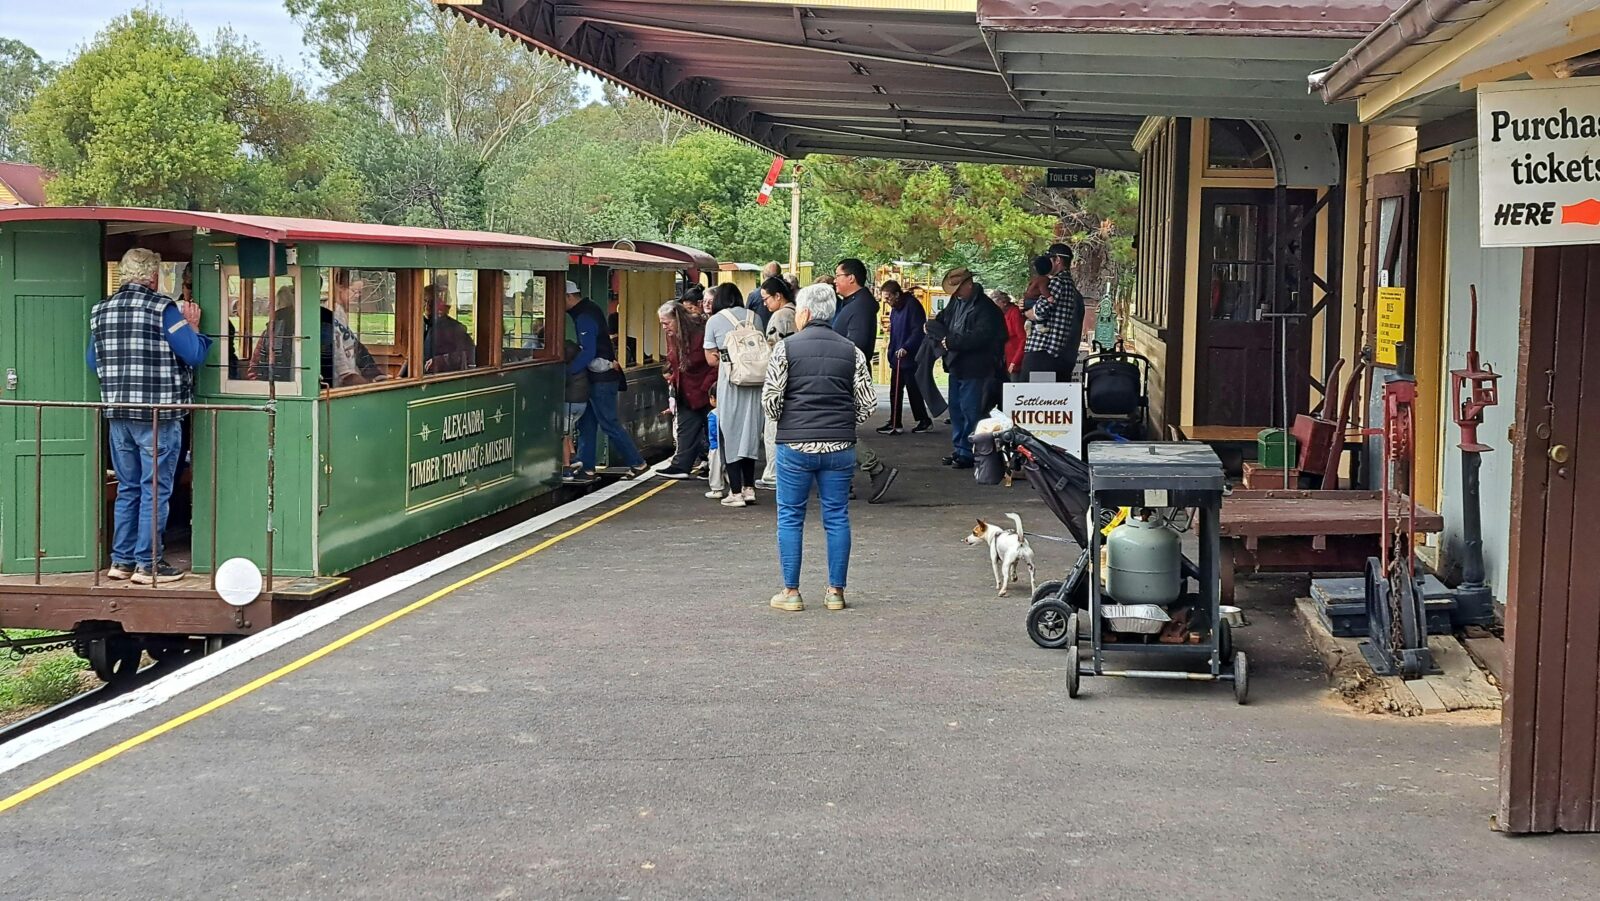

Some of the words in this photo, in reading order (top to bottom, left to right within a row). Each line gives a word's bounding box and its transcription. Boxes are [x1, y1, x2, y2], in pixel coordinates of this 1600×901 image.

[1491, 108, 1600, 142] Purcha
[1050, 173, 1078, 181] TOILETS
[1494, 202, 1555, 226] HERE
[1015, 395, 1068, 406] Settlement
[442, 409, 484, 441] ALEXANDRA
[1012, 411, 1073, 424] KITCHEN
[411, 457, 439, 487] TIMBER
[442, 445, 479, 478] TRAMWAY
[485, 437, 512, 465] MUSEUM
